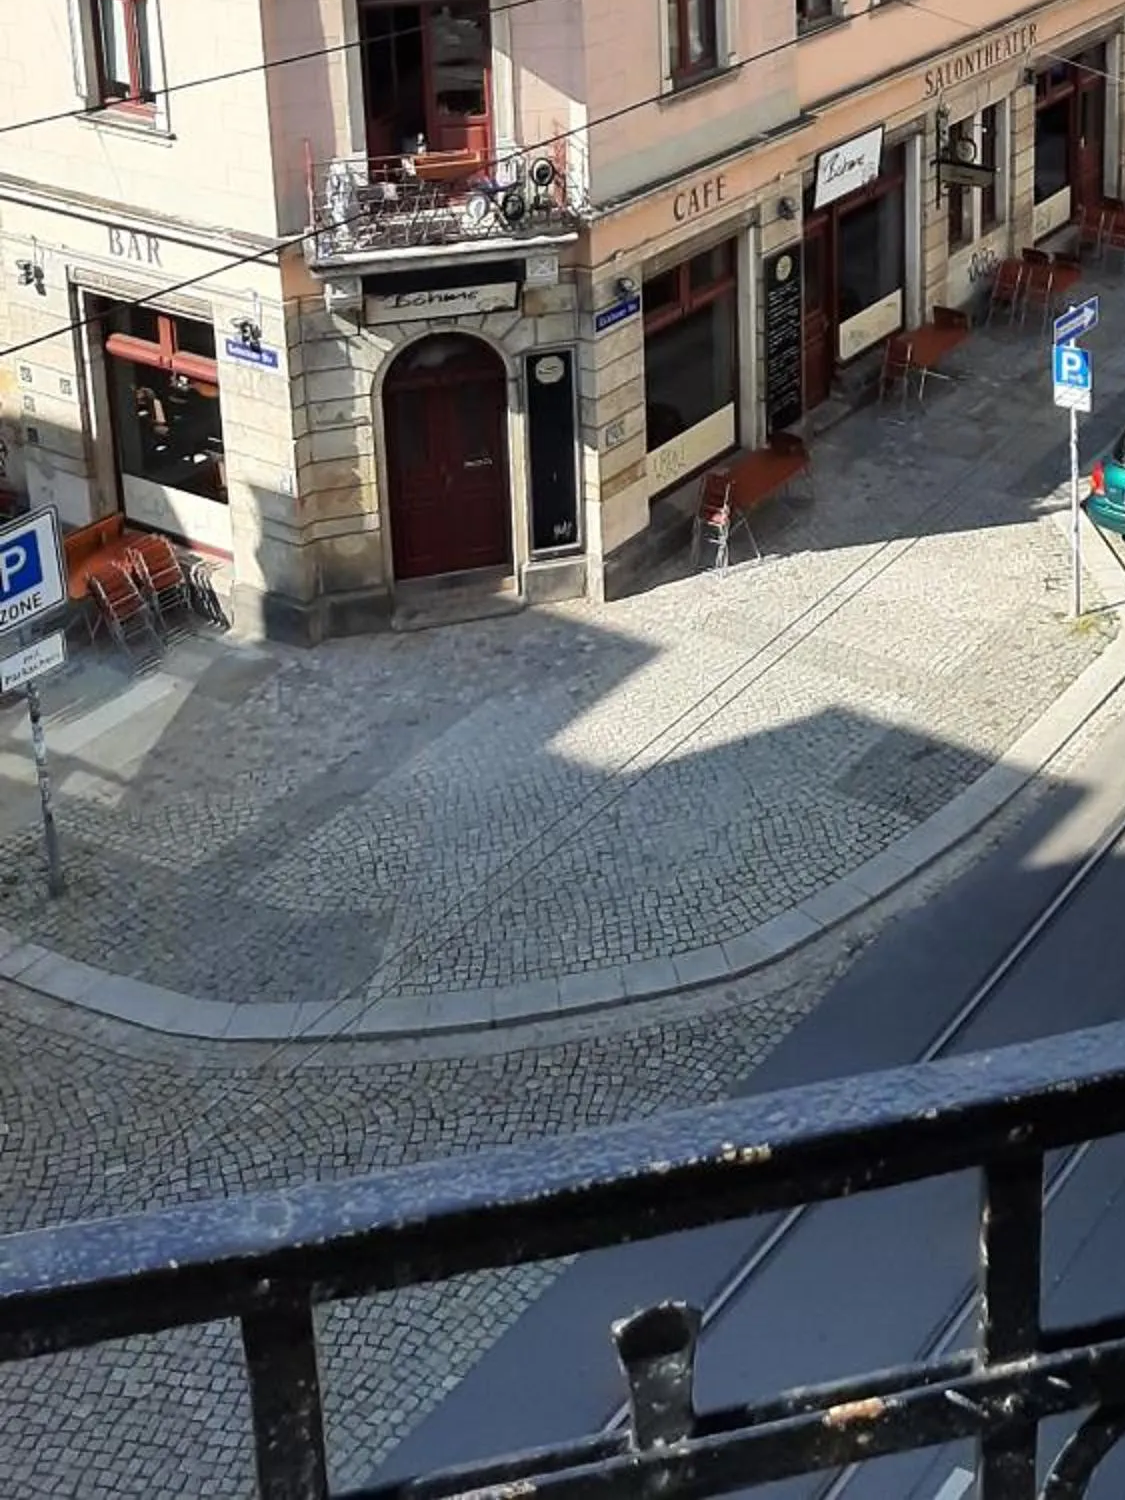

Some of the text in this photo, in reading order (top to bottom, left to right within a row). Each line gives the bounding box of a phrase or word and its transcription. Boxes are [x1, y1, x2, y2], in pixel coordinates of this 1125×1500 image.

[924, 23, 1037, 96] SALONTHEATER
[108, 225, 164, 268] BAR
[1061, 351, 1082, 382] P
[0, 544, 27, 593] P
[0, 591, 42, 624] ZONE
